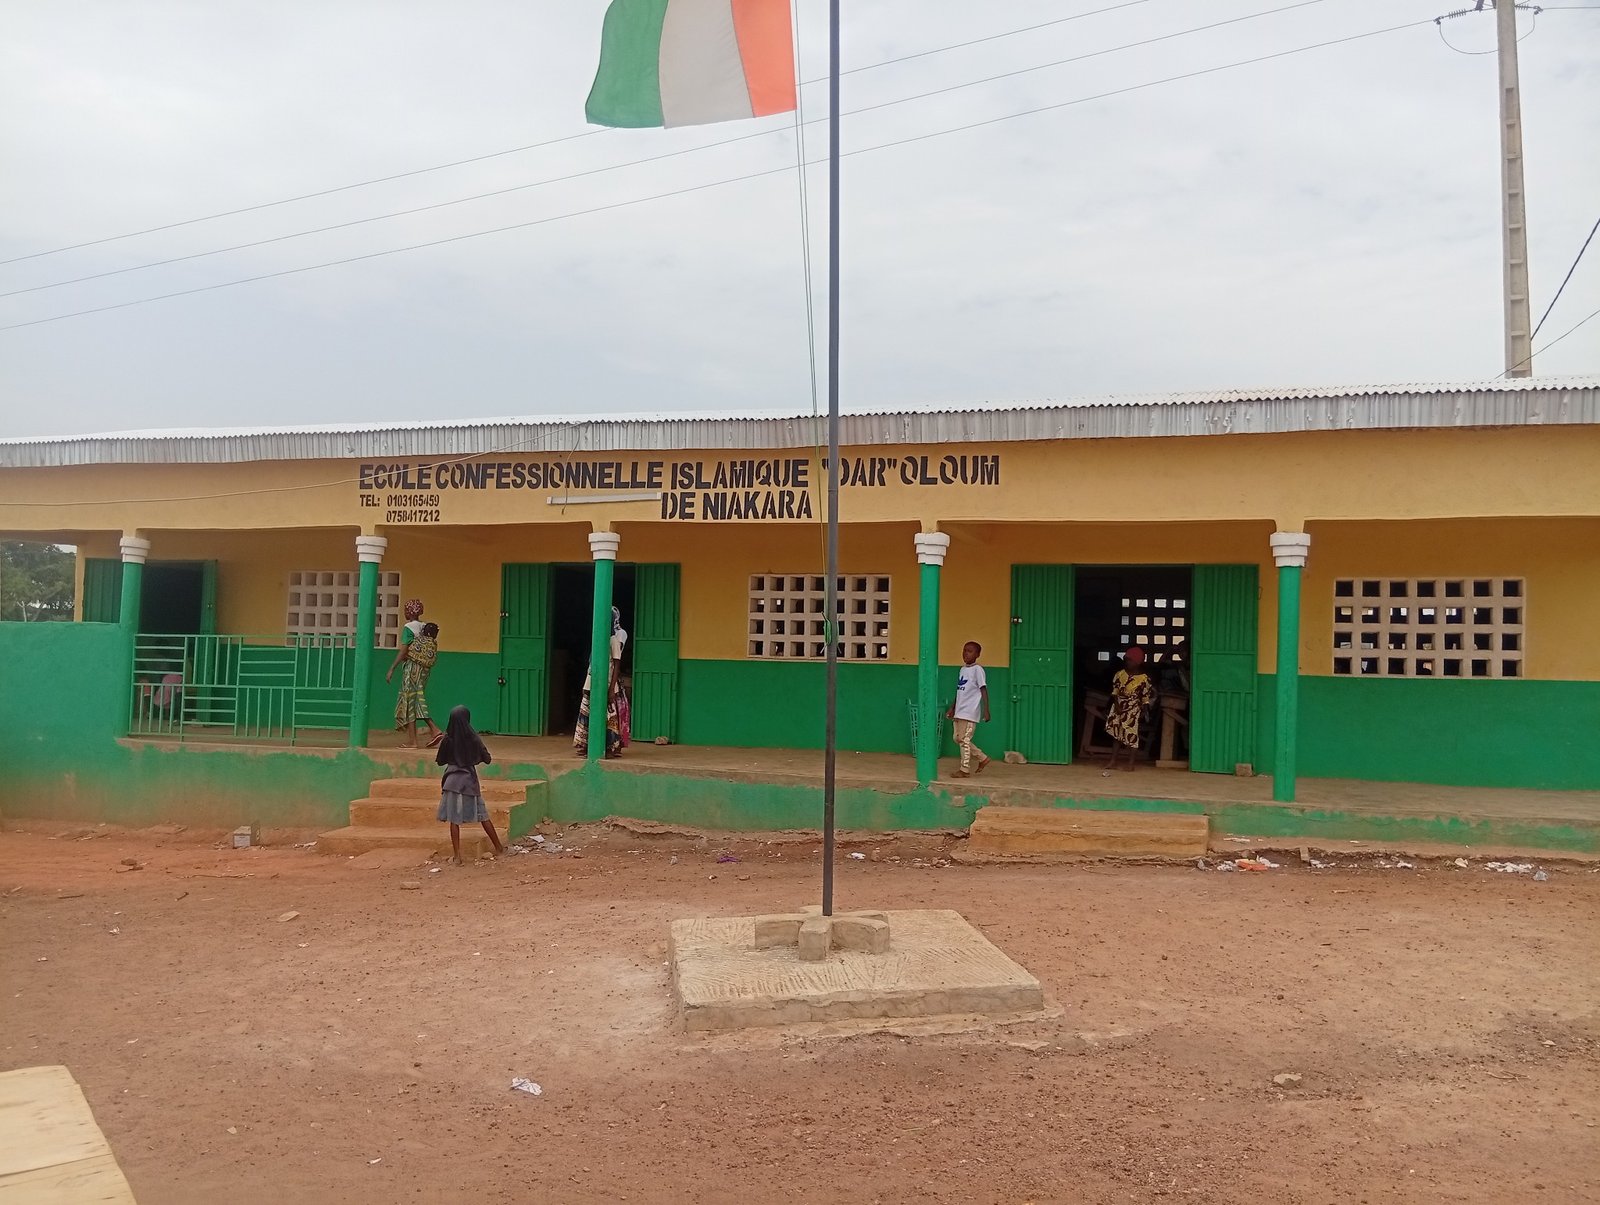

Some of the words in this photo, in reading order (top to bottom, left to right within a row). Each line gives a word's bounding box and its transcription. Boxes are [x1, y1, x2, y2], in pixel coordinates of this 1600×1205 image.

[359, 464, 432, 490] ECOLE
[435, 461, 663, 489] CONFESSIONNELLE
[671, 459, 809, 490] ISLAMIQUE
[359, 494, 381, 507] TEL:
[387, 494, 440, 507] 0103165459
[661, 491, 696, 520] DE
[702, 490, 813, 520] NIAKARA
[386, 509, 440, 523] 0758417212
